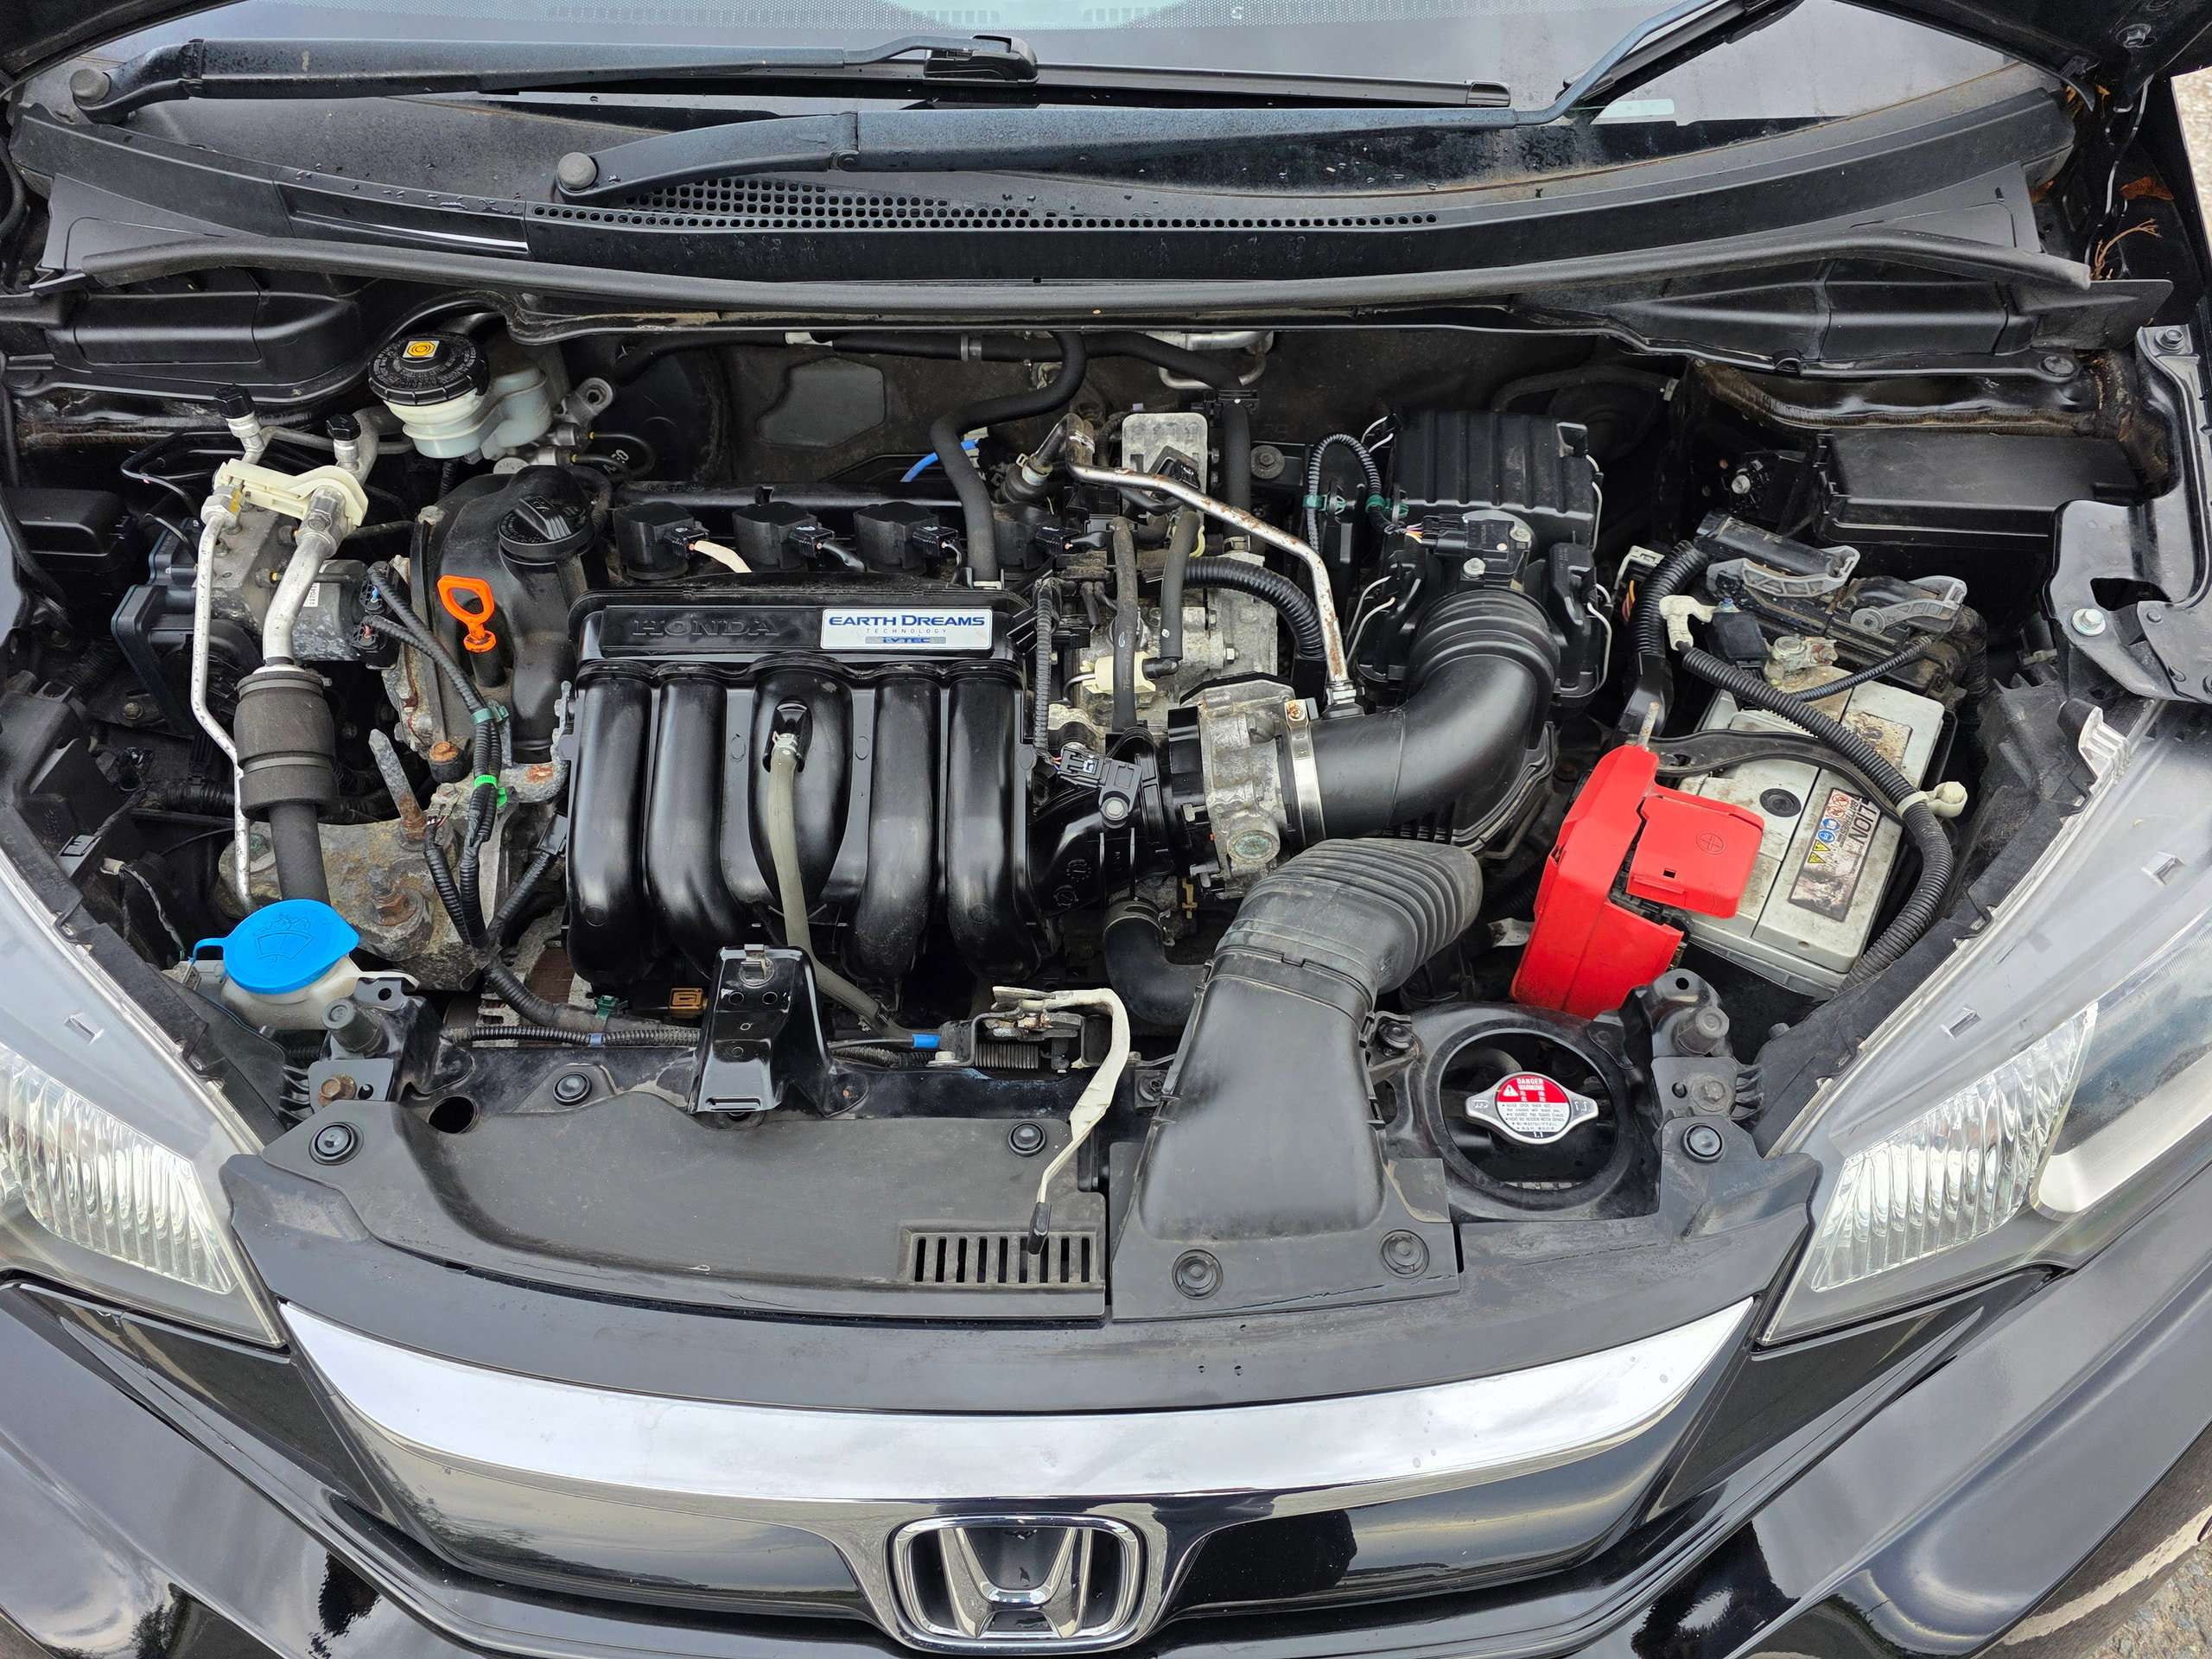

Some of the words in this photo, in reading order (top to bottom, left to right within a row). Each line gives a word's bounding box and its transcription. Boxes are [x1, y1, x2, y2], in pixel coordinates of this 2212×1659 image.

[632, 620, 780, 637] HONDA
[829, 616, 897, 626] EARTH
[901, 614, 986, 626] DREAMS
[1848, 804, 1878, 846] LION
